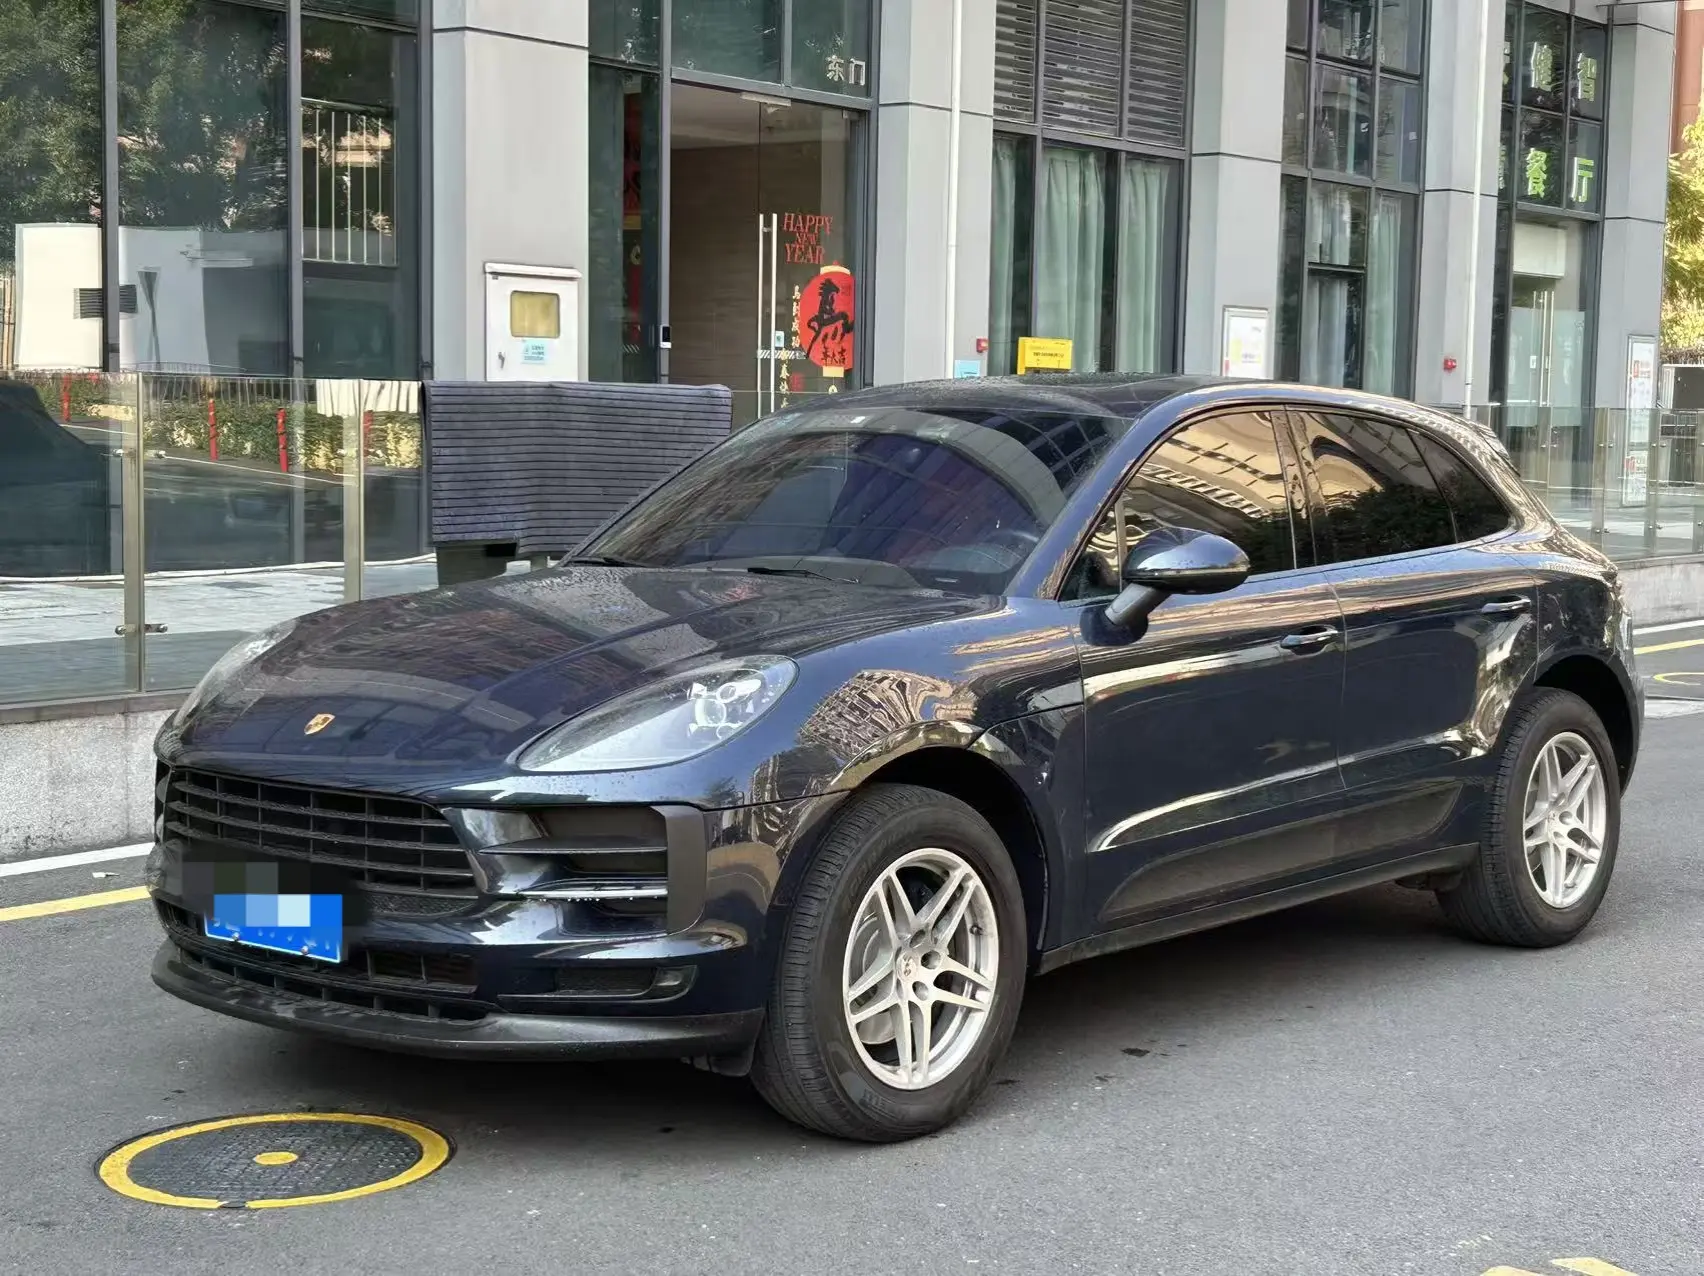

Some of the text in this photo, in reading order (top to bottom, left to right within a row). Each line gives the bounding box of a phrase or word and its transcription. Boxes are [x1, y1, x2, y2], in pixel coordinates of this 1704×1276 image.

[826, 55, 866, 86] 东门
[783, 212, 833, 236] HAPPY
[796, 231, 817, 246] NEW
[785, 243, 825, 264] YEAR
